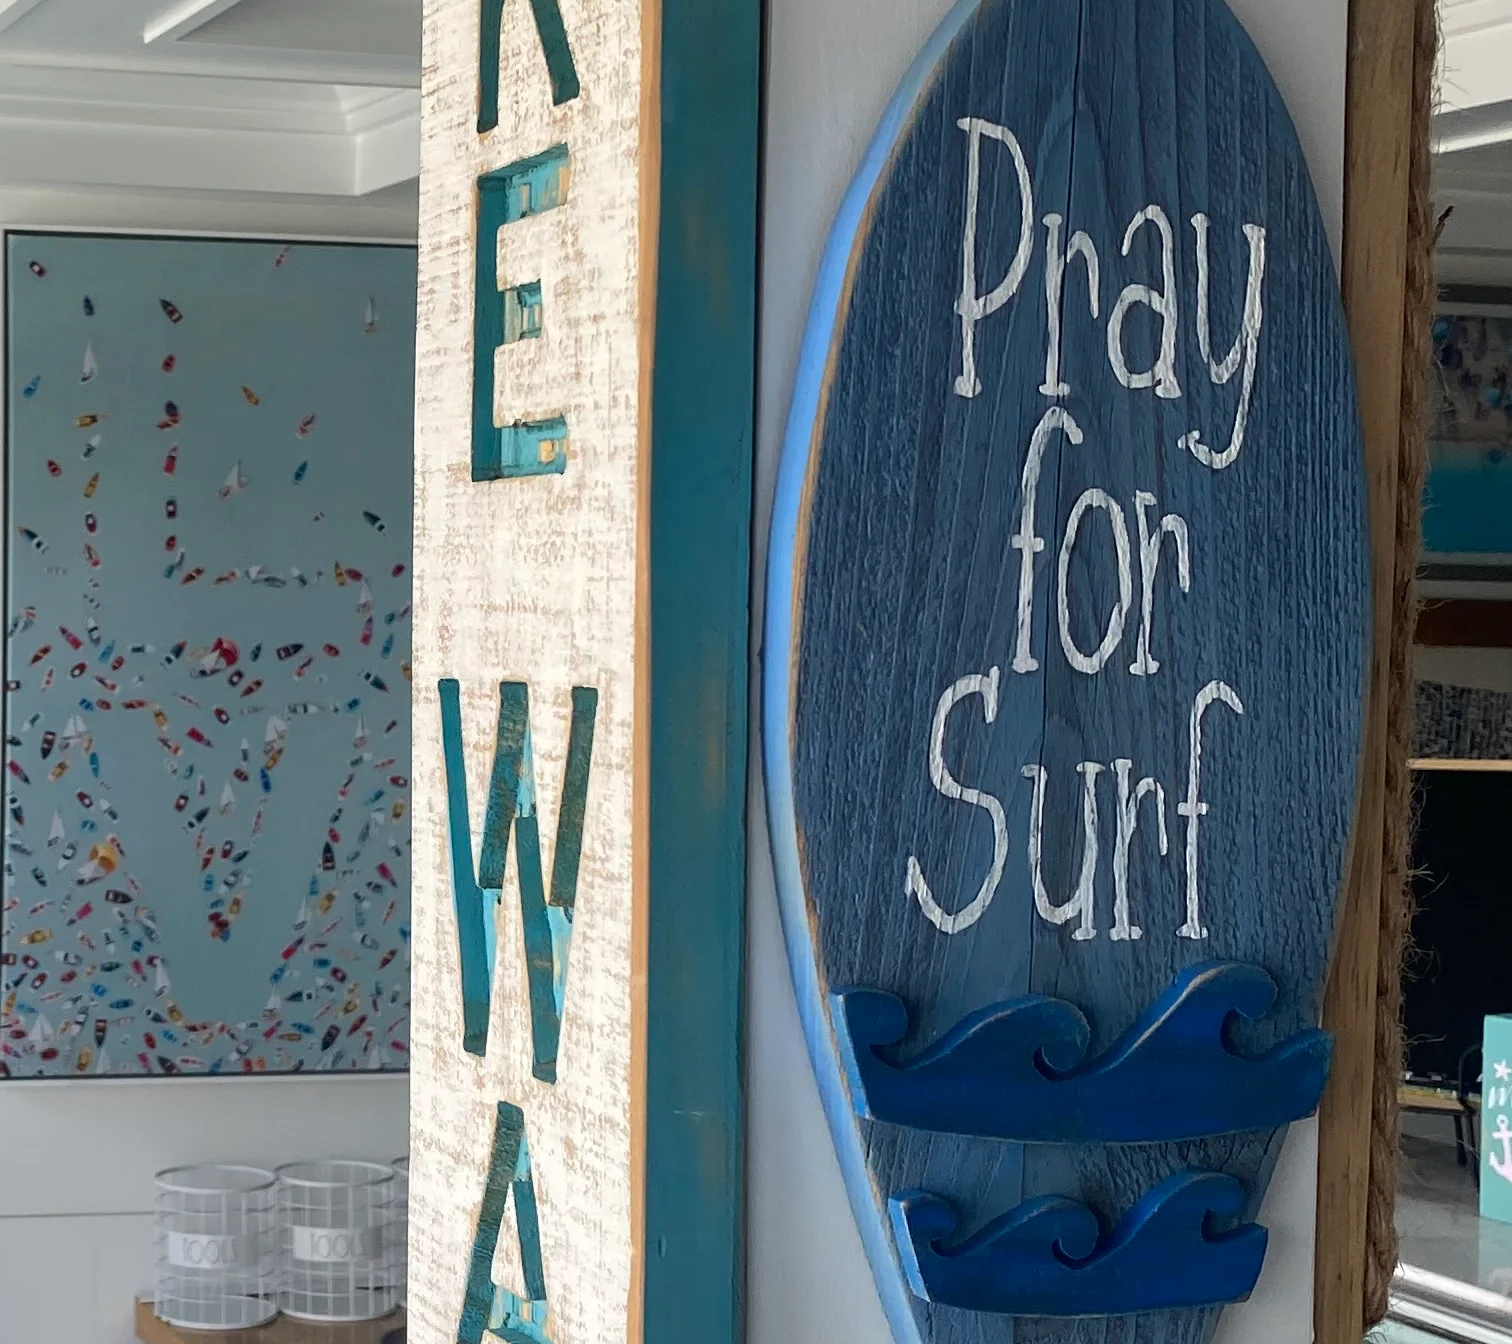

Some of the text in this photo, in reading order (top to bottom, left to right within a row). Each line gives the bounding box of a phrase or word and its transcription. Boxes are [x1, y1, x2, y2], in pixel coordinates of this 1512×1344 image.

[952, 115, 1267, 470] Pray
[1010, 404, 1191, 676] for
[903, 665, 1245, 942] Surf
